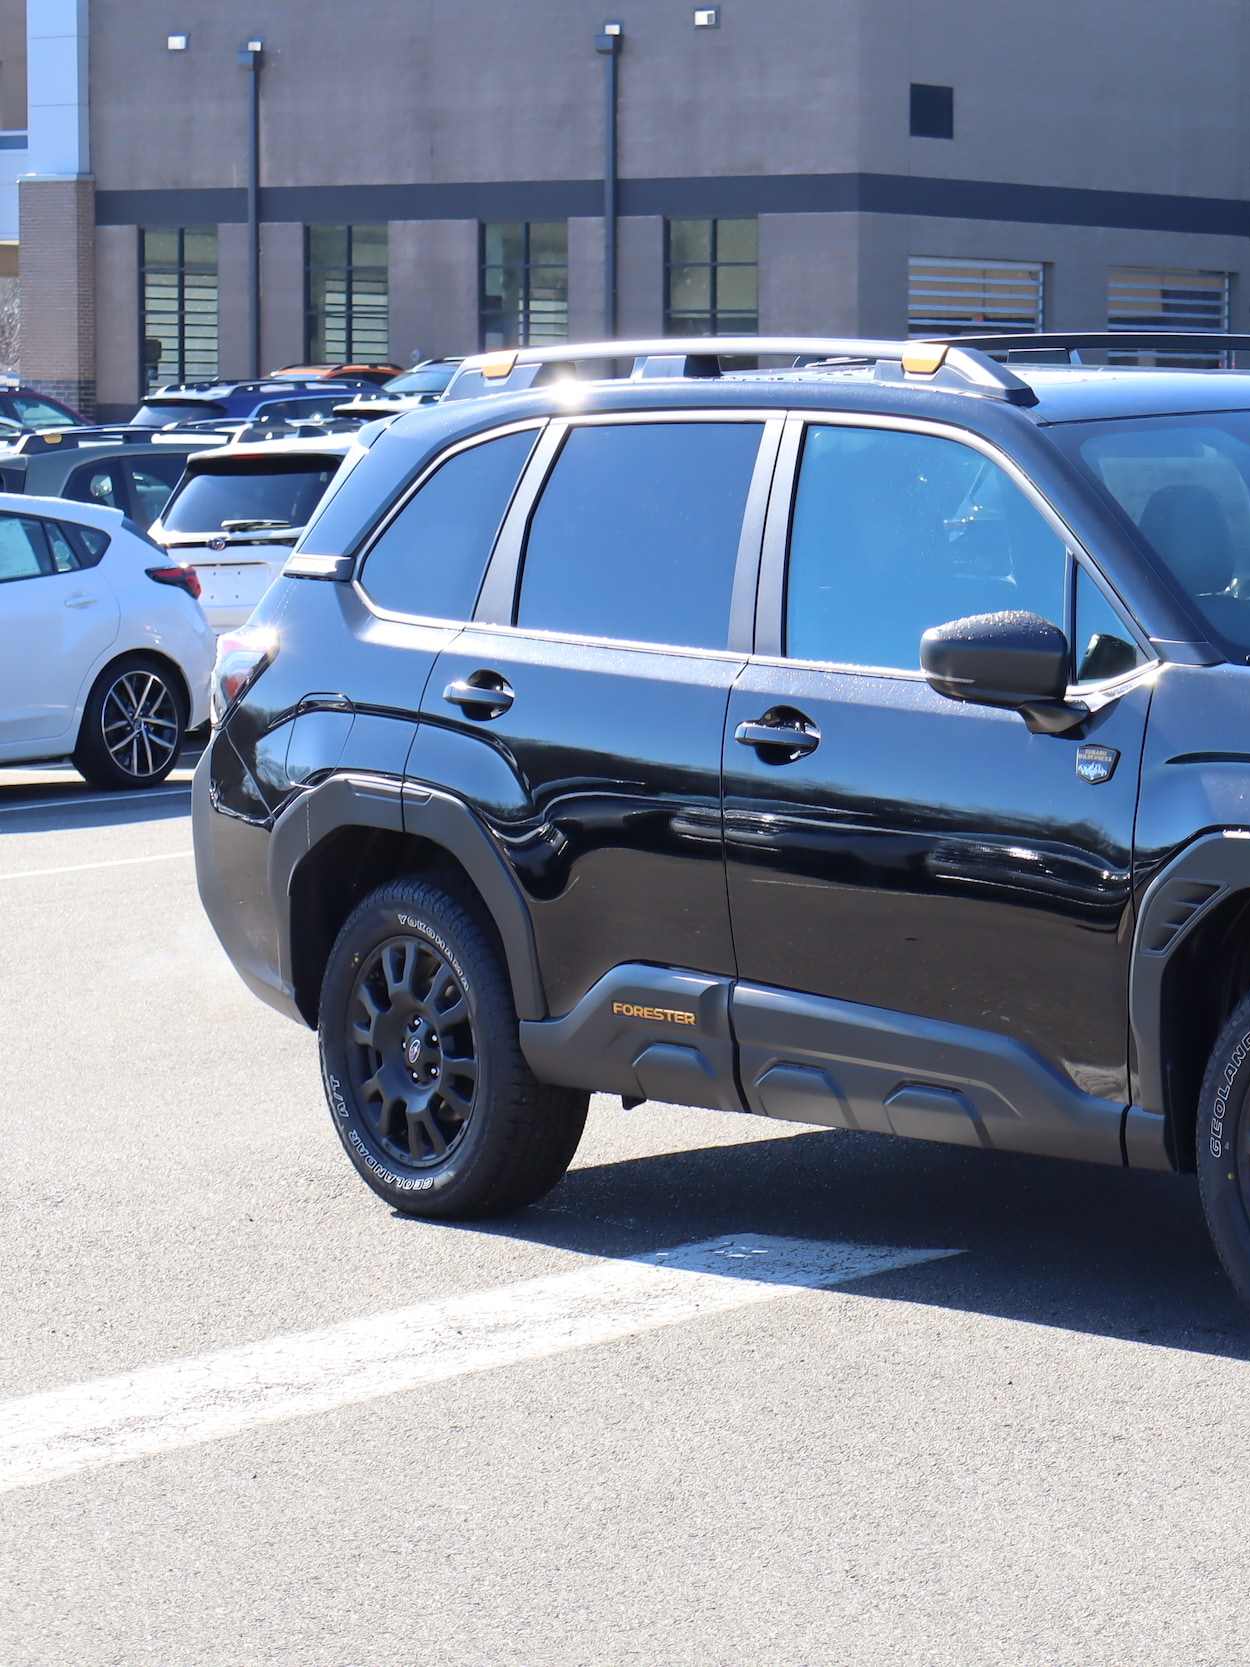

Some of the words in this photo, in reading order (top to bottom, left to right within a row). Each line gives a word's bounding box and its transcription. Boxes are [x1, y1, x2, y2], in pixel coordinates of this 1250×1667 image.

[397, 913, 470, 992] YOKOHAMA
[612, 1002, 696, 1026] FORESTER
[330, 1074, 349, 1118] A/T
[349, 1129, 434, 1191] GEOLANDAR
